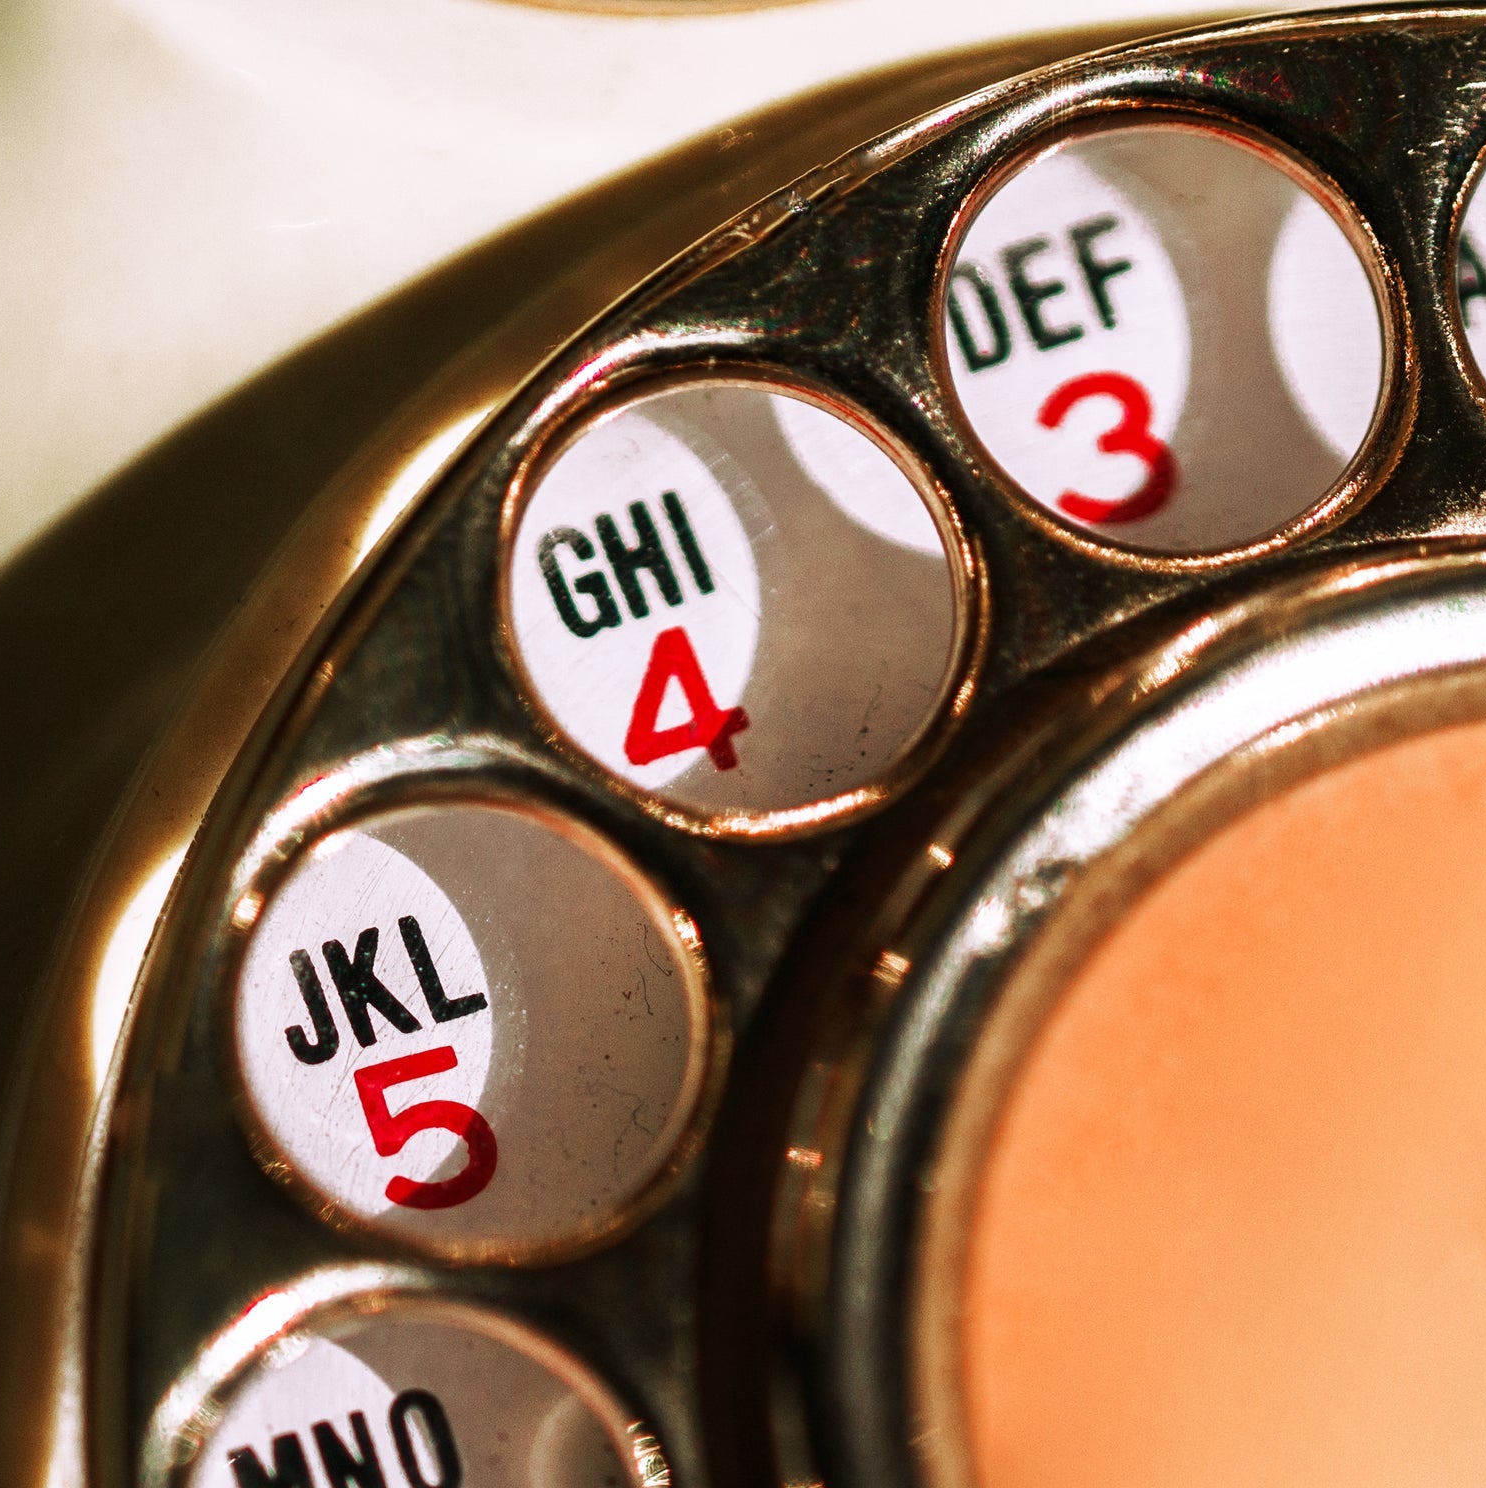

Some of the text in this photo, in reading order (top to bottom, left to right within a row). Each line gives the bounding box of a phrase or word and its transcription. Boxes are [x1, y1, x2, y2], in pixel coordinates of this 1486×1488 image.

[947, 211, 1134, 374] DEF
[1036, 371, 1176, 527] 3
[542, 491, 715, 638] GHI
[622, 625, 749, 771] 4
[285, 914, 489, 1066] JKL
[352, 1045, 497, 1211] 5
